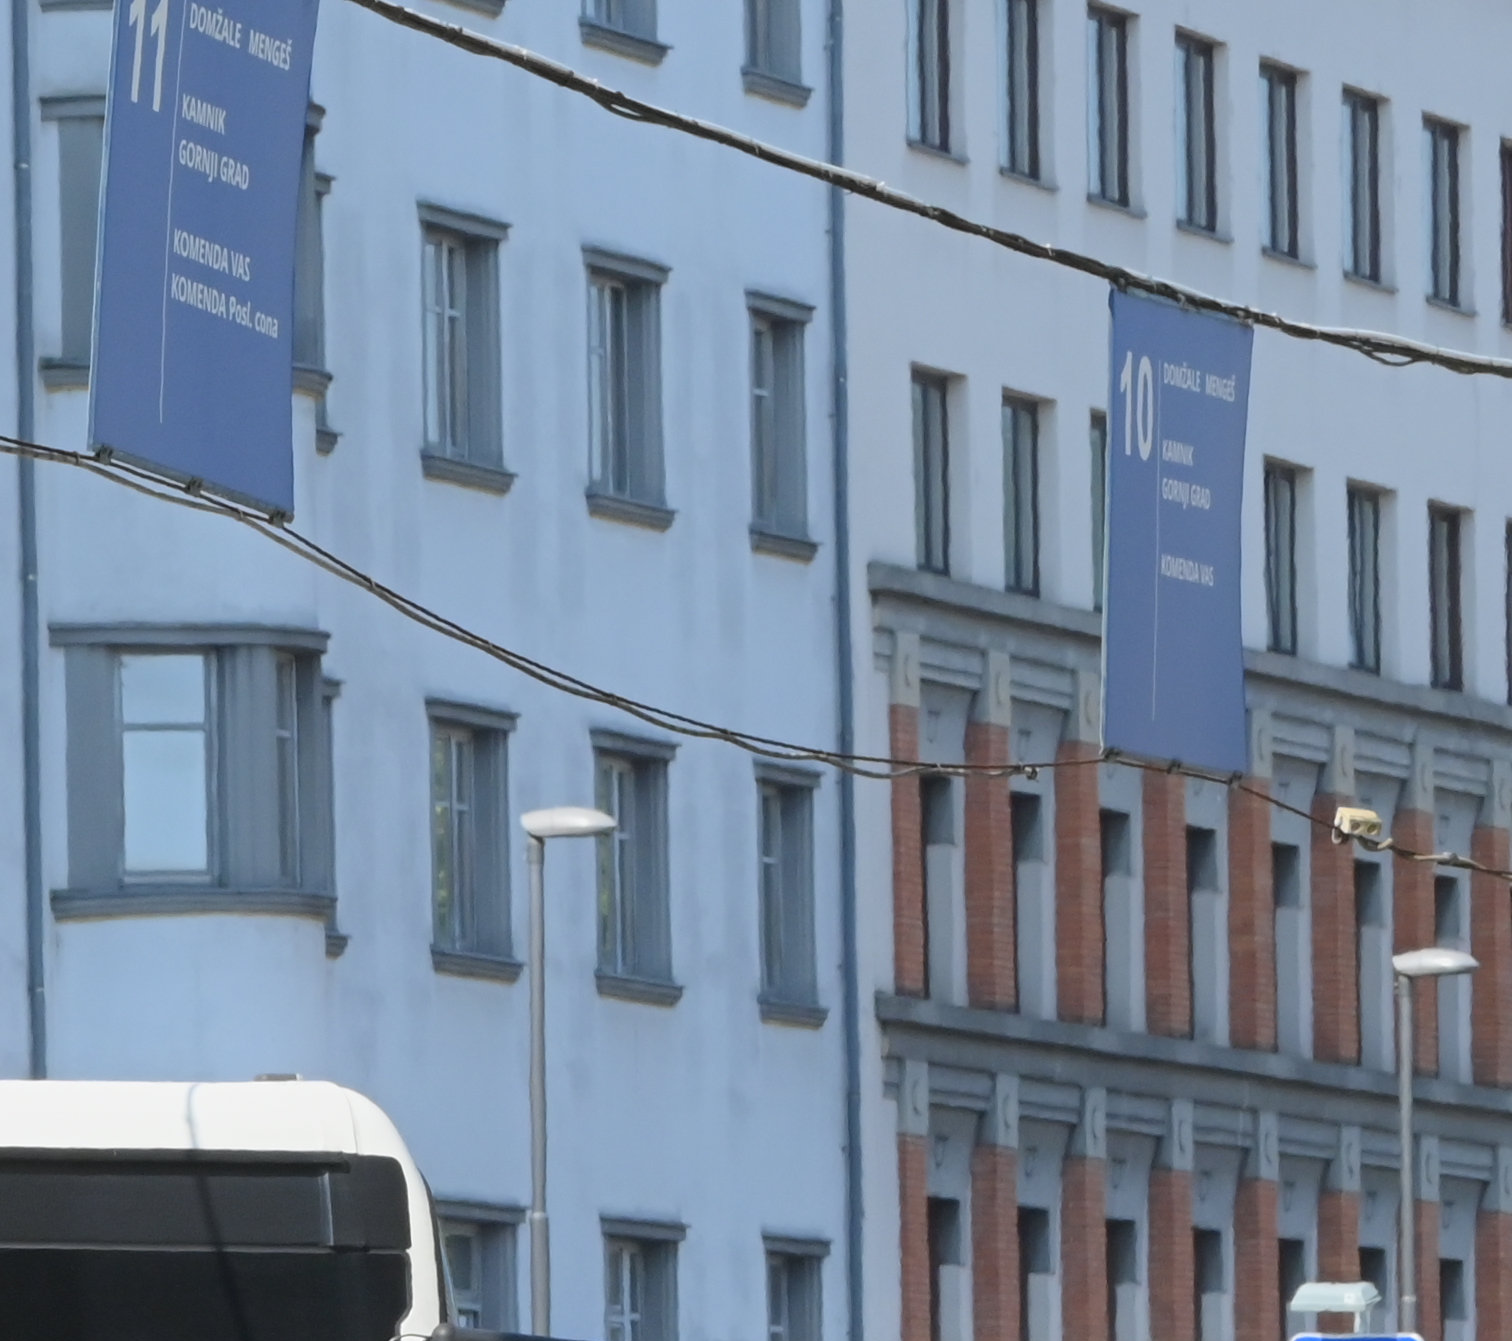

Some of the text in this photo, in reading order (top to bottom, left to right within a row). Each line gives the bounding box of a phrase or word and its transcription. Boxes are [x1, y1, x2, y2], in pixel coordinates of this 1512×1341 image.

[129, 0, 168, 112] 11
[189, 3, 293, 71] DOMŽALE MENGEŠ
[181, 93, 227, 135] KAMNIK
[179, 139, 250, 190] GORNJI GRAD
[173, 228, 251, 281] KOMENDA VAS
[170, 272, 279, 339] KOMENDA Posl. cona
[1163, 362, 1201, 393] DOMŽALE
[1120, 350, 1154, 461] 10
[1162, 440, 1194, 466] KAMNIK
